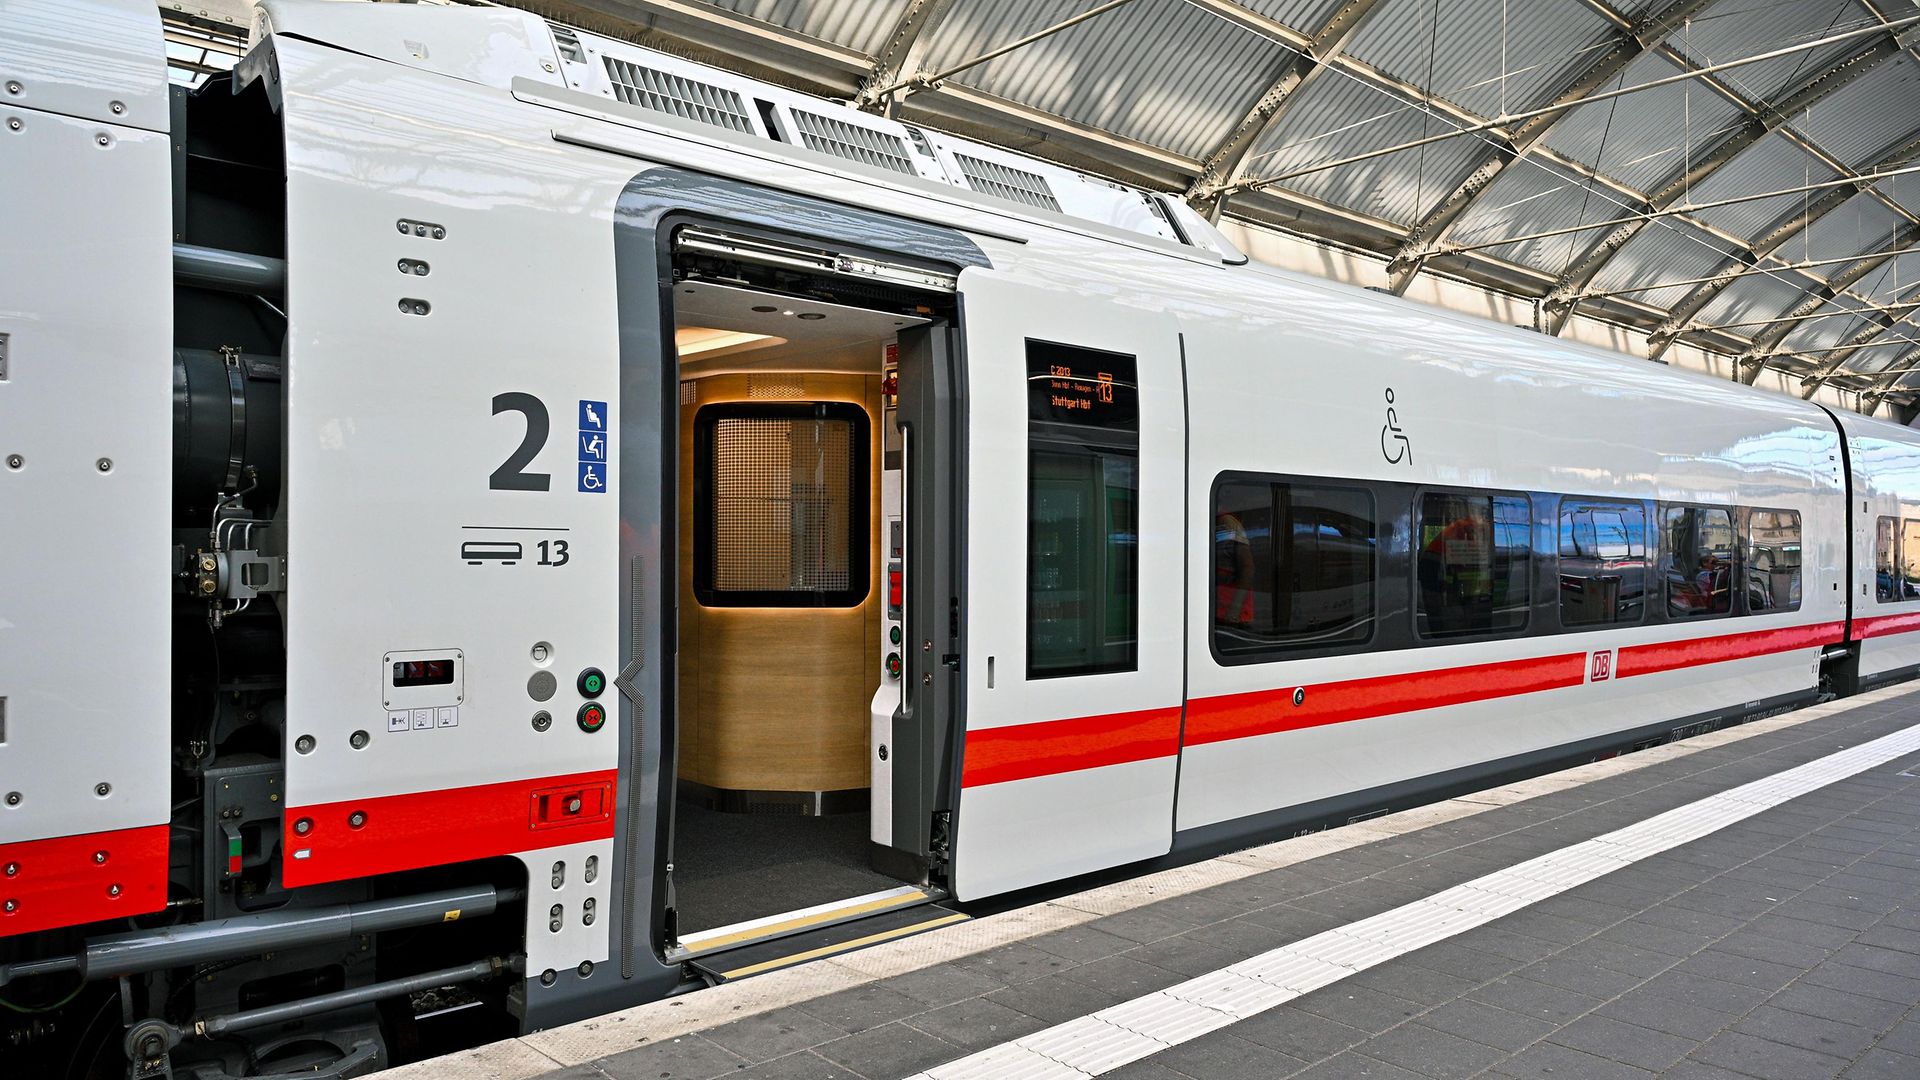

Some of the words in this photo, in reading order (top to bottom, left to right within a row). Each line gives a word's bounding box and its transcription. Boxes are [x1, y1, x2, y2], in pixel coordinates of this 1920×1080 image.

[1056, 366, 1071, 377] 2013
[1052, 395, 1079, 409] Stuttgart
[1080, 398, 1091, 410] Hbf
[1100, 383, 1112, 402] 13
[489, 391, 551, 492] 2
[537, 540, 570, 567] 13
[1593, 654, 1609, 678] DB
